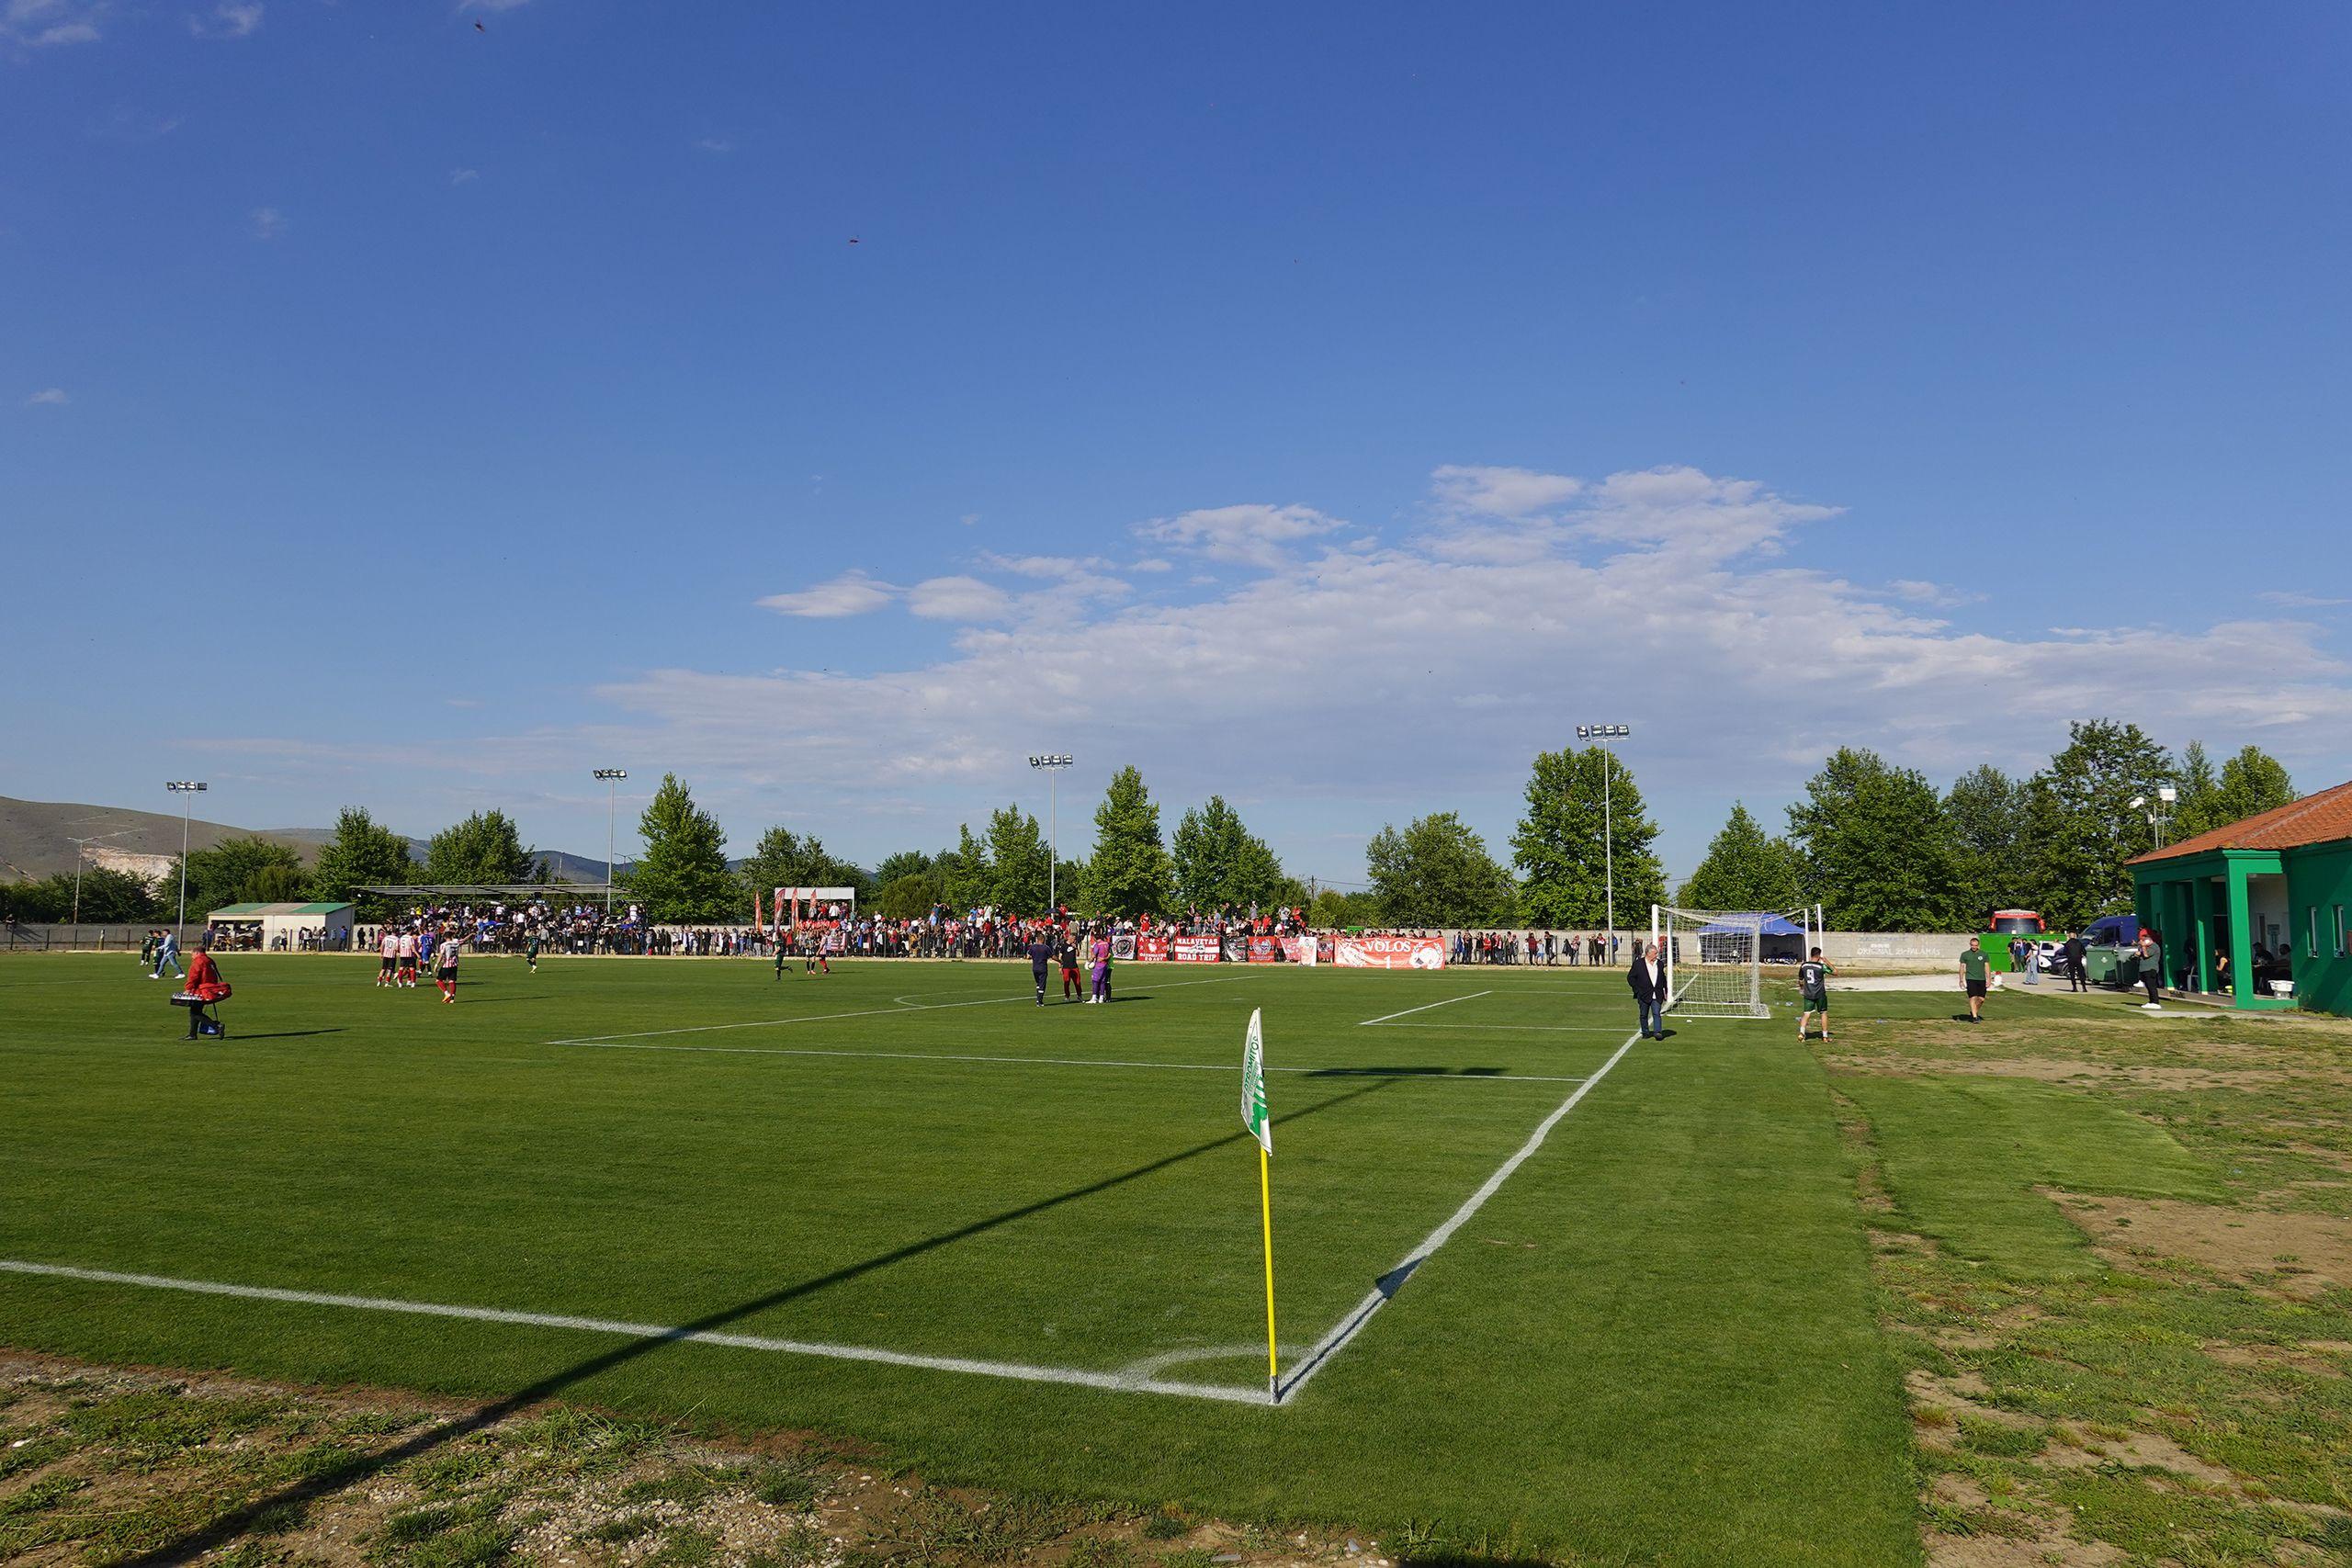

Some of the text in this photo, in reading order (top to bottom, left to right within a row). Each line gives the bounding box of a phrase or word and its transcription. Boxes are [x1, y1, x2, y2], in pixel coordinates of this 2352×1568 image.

[1365, 941, 1411, 952] VOLOS
[1384, 955, 1391, 969] 1
[1806, 969, 1815, 984] 9
